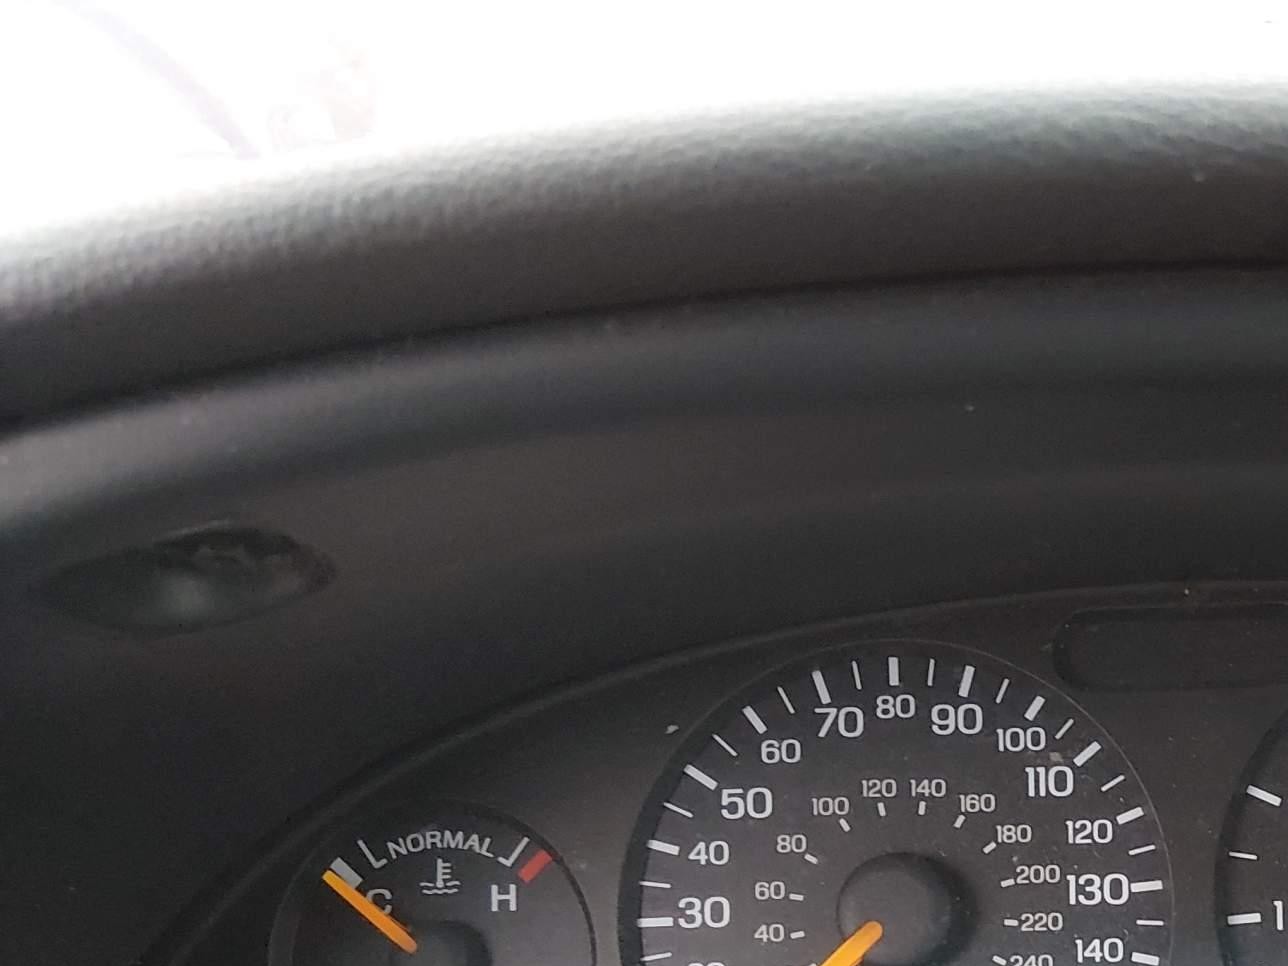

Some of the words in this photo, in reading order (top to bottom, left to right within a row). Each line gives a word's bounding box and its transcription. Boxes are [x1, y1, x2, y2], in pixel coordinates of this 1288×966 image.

[877, 695, 915, 718] 80
[815, 707, 863, 737] 70
[932, 704, 982, 735] 90
[997, 727, 1045, 751] 100
[761, 739, 800, 763] 60
[862, 779, 896, 797] 120
[910, 779, 946, 797] 140
[1026, 766, 1073, 796] 110
[722, 788, 772, 819] 50
[812, 797, 849, 815] 100
[960, 794, 995, 812] 160
[997, 825, 1031, 843] 180
[1066, 820, 1112, 843] 120
[387, 831, 494, 858] NORMAL
[689, 841, 729, 864] 40
[777, 835, 806, 852] 80
[1016, 865, 1060, 883] 200
[492, 884, 516, 911] H
[755, 882, 785, 899] 60
[1067, 874, 1129, 905] 130
[679, 897, 730, 928] 30
[1021, 913, 1062, 931] 220
[1274, 901, 1283, 930] 1
[755, 924, 784, 942] 40
[1076, 938, 1123, 962] 140
